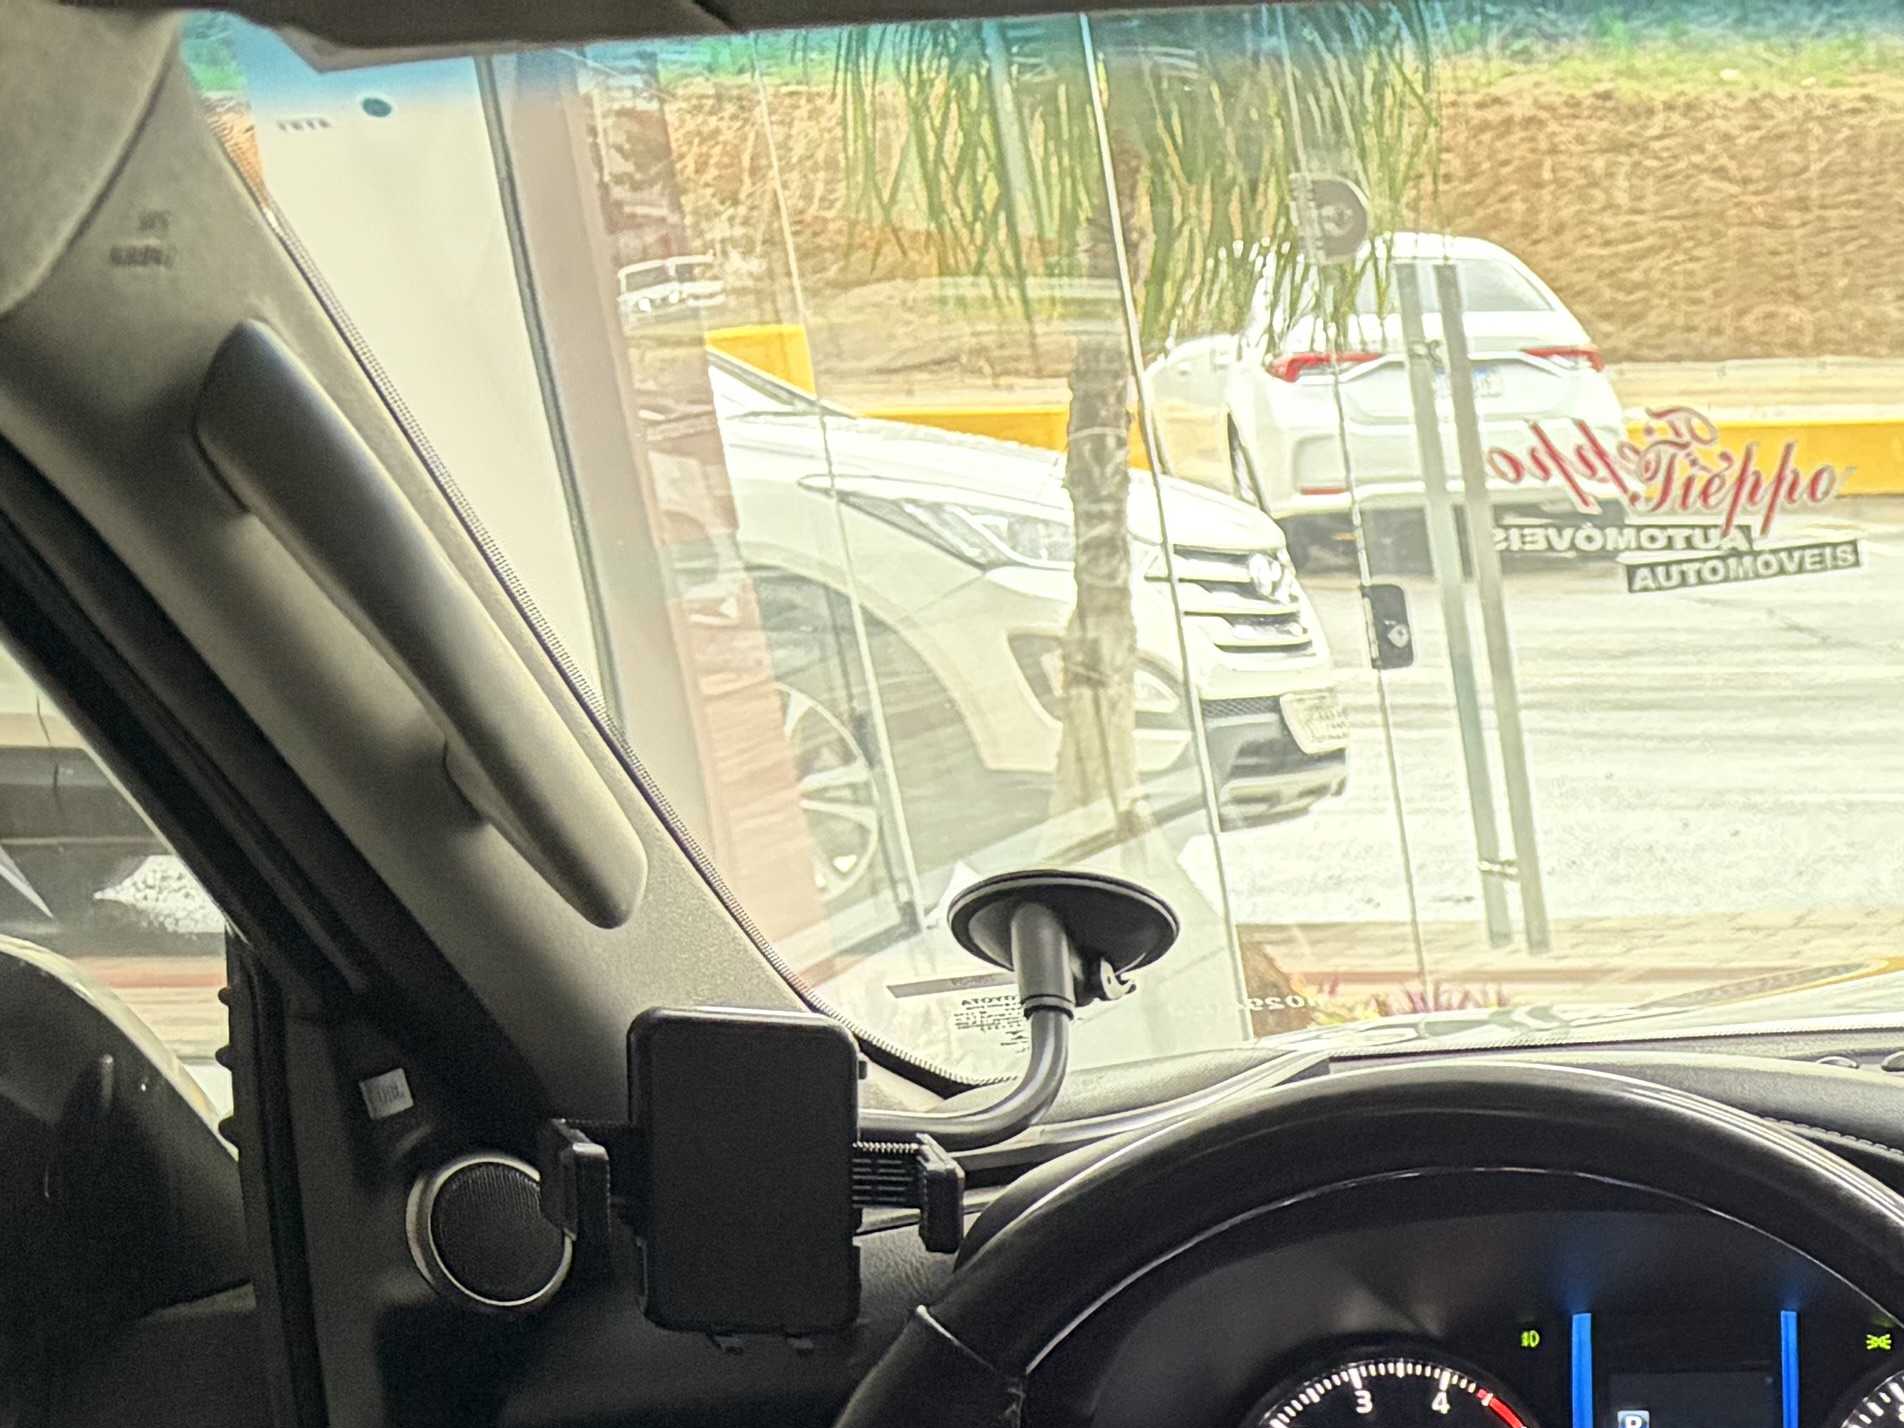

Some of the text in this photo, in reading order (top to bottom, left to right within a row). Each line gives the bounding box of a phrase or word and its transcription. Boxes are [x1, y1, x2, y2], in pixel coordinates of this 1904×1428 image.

[1639, 440, 1855, 537] Tieppo
[1632, 543, 1857, 593] AUTOMÓVEIS
[1356, 1392, 1373, 1414] 3
[1432, 1392, 1450, 1415] 4
